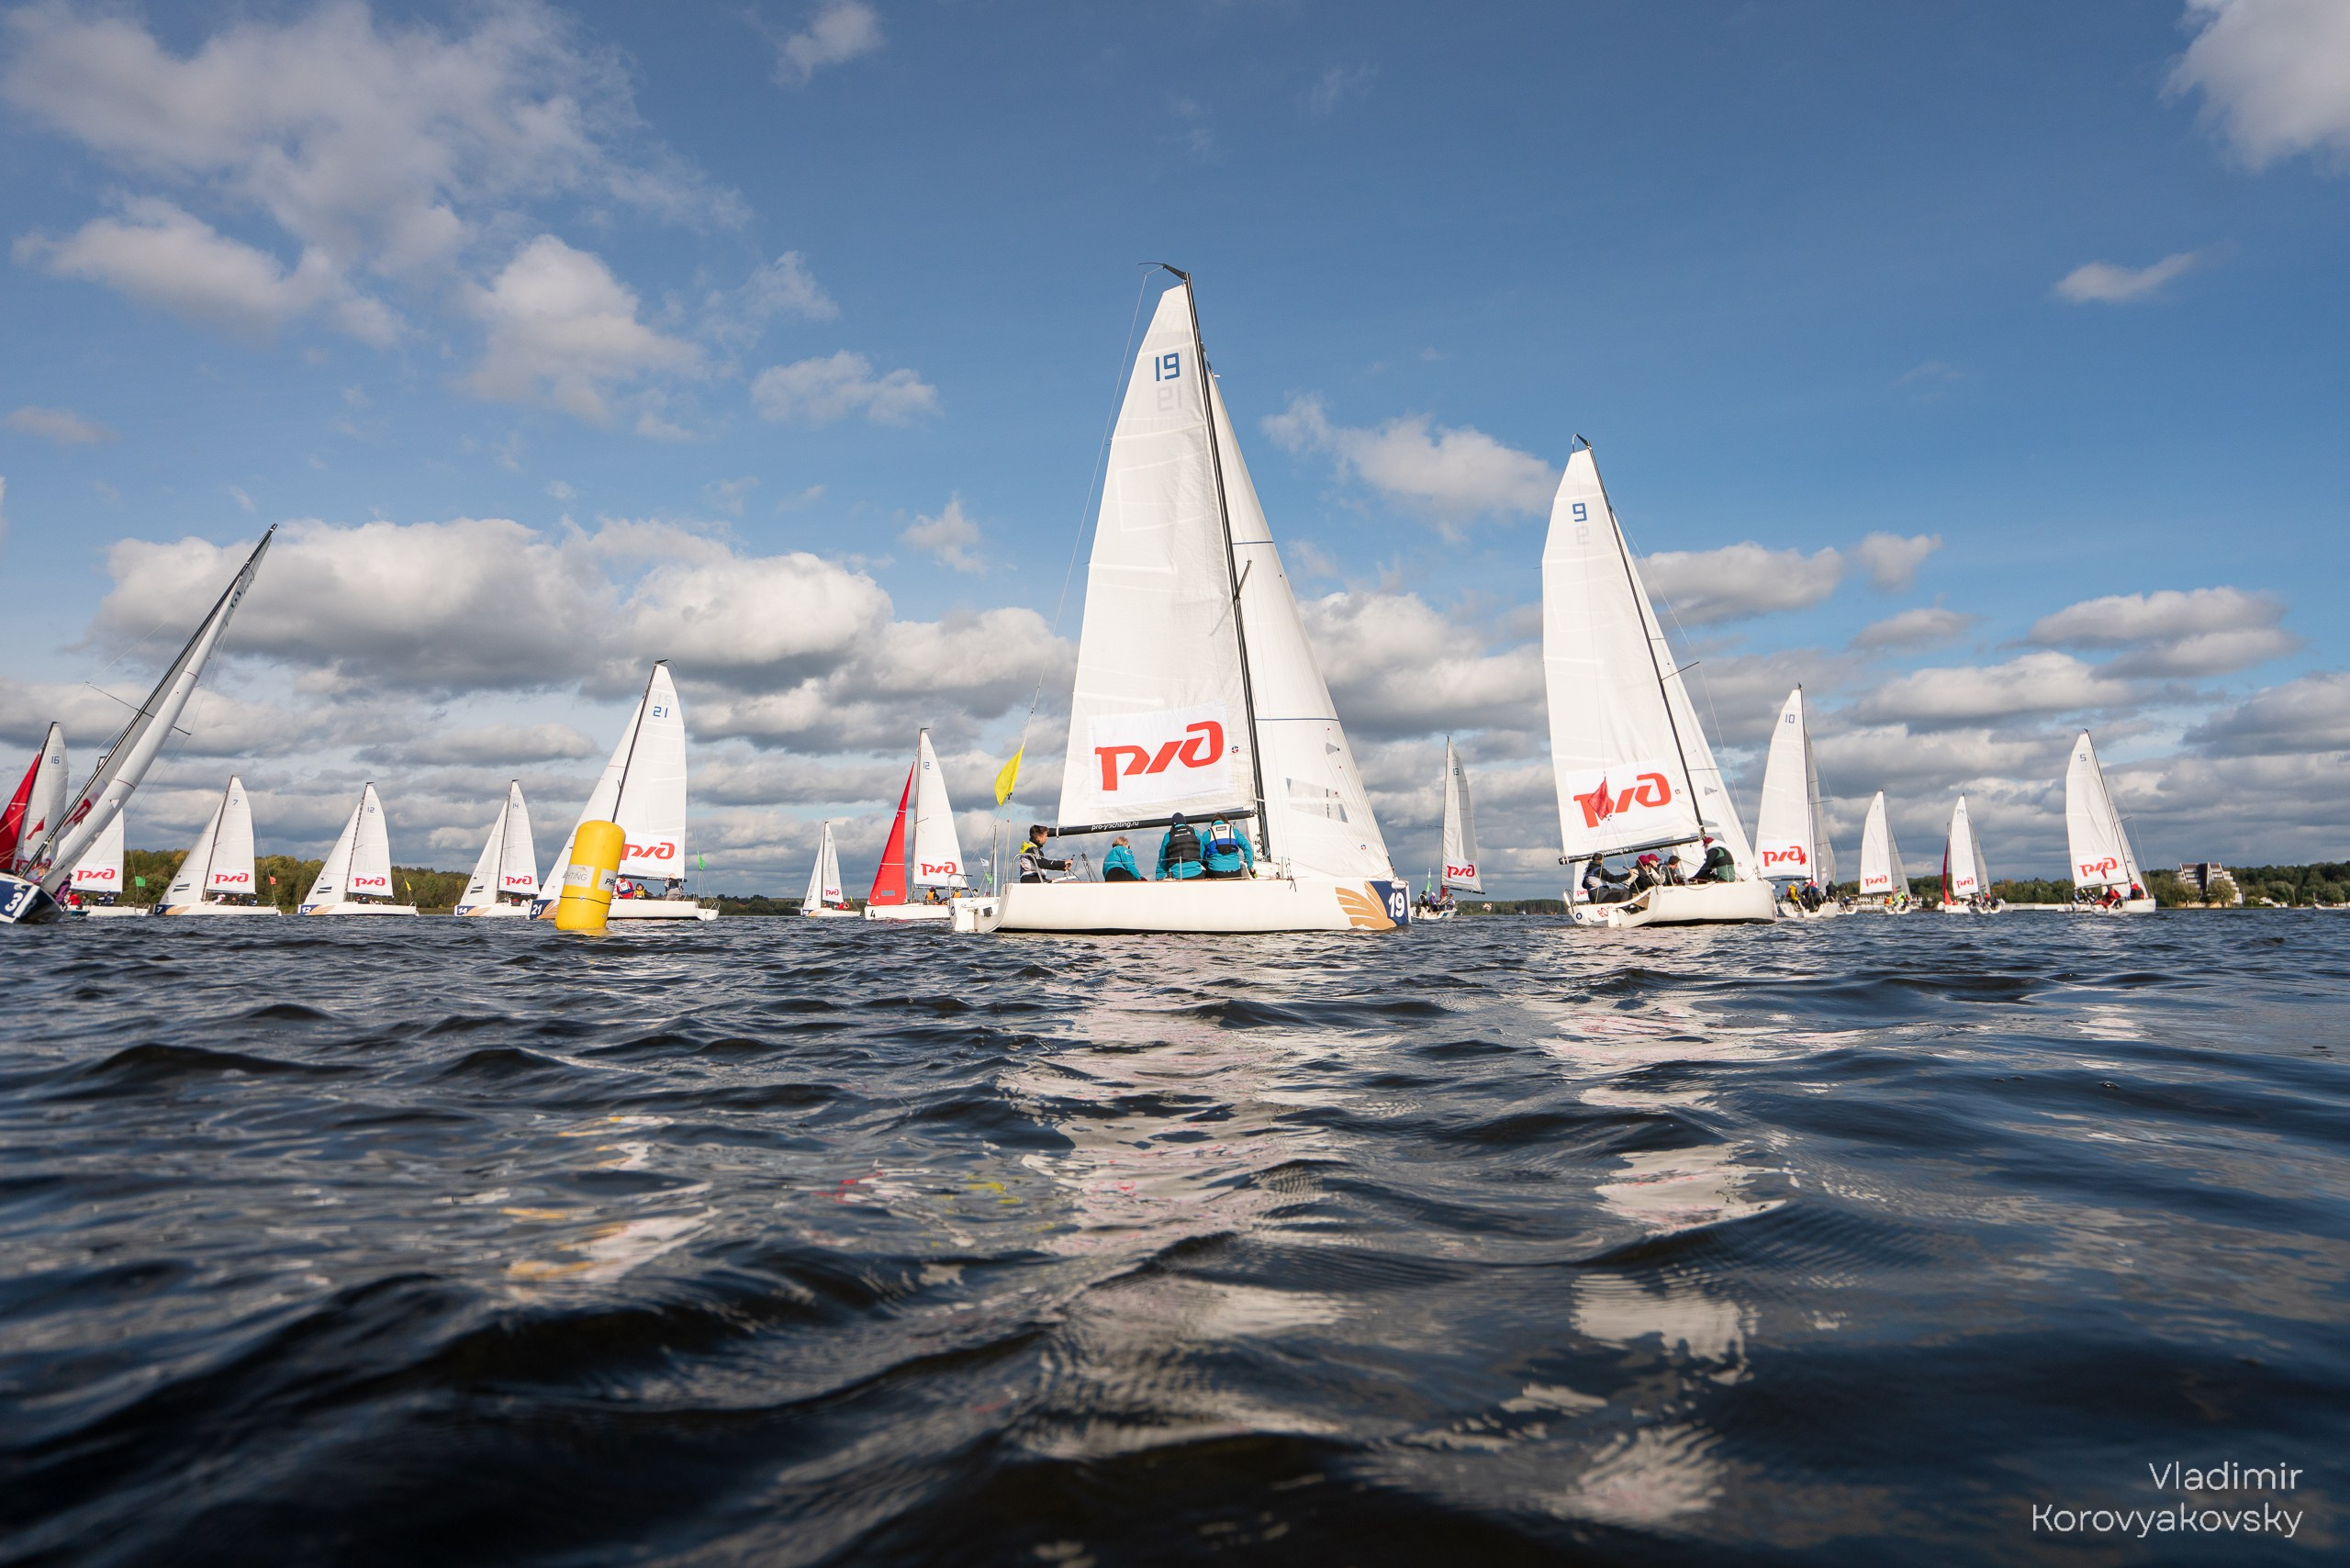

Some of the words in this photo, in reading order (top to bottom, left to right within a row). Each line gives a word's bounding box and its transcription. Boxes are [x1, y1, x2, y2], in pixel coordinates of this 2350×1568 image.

[1155, 352, 1181, 382] 19
[1572, 502, 1587, 522] 9
[653, 705, 668, 719] 21
[1785, 713, 1796, 724] 10
[50, 756, 61, 765] 16
[2079, 753, 2087, 762] 5
[923, 761, 930, 769] 12
[5, 892, 24, 913] 3
[532, 903, 543, 915] 21
[1387, 891, 1405, 918] 19
